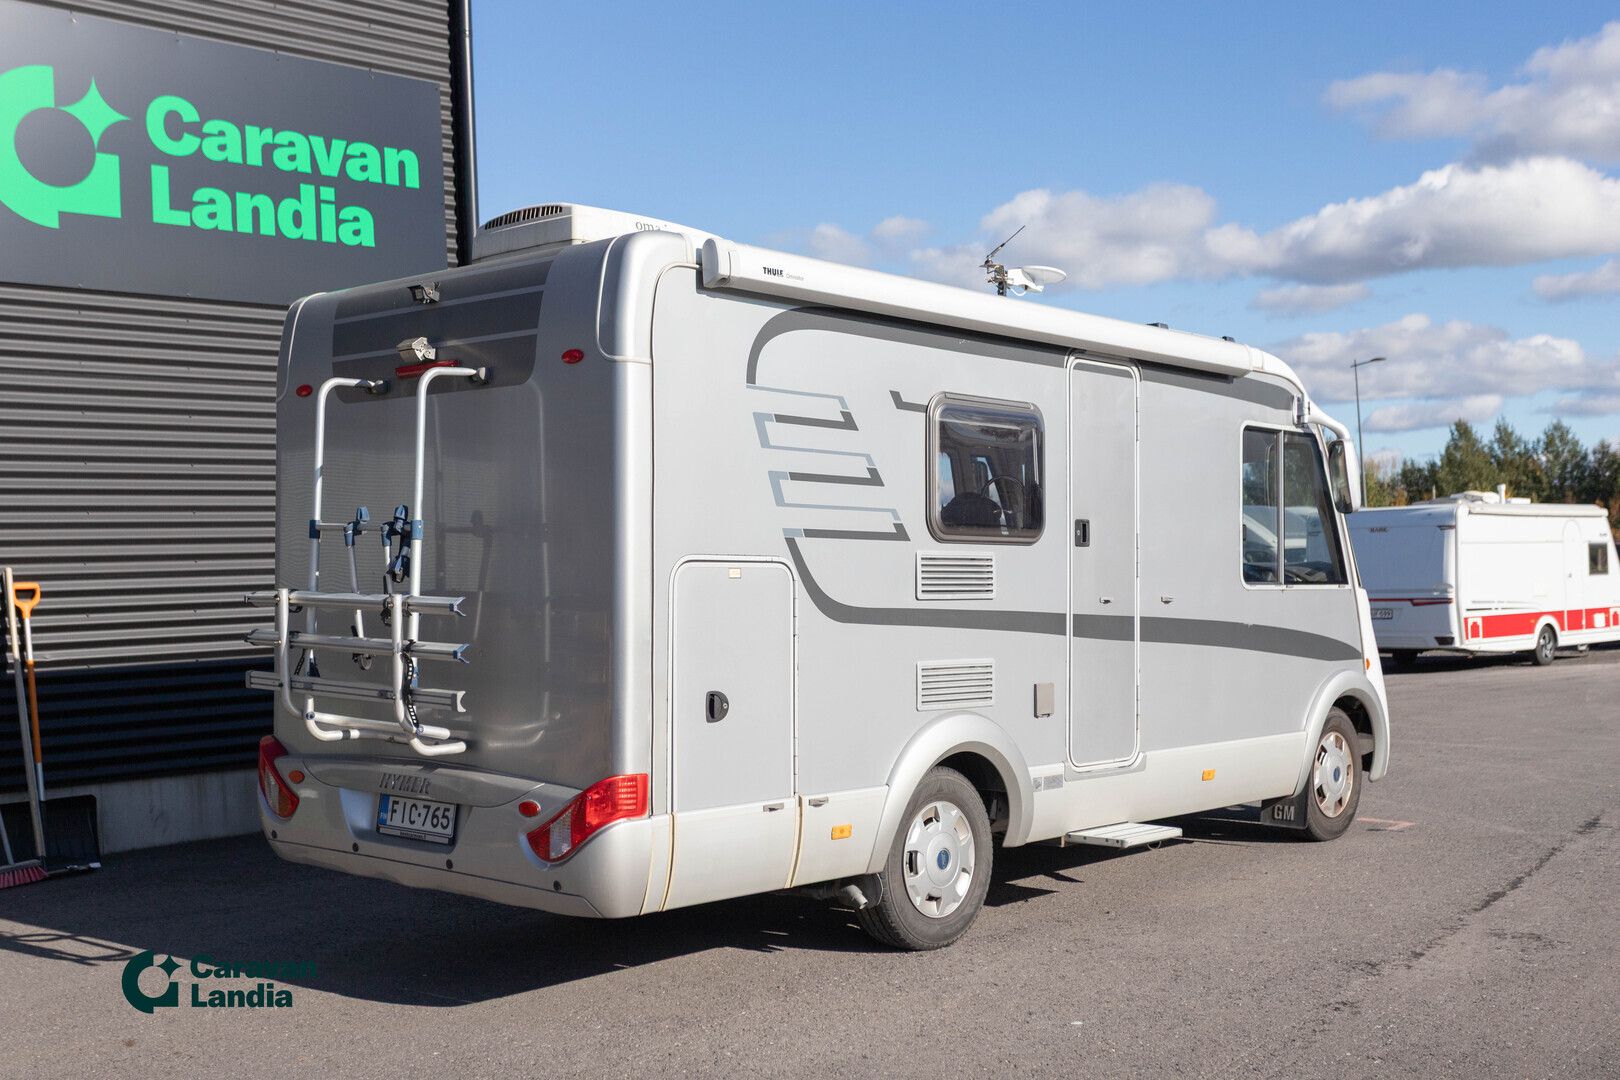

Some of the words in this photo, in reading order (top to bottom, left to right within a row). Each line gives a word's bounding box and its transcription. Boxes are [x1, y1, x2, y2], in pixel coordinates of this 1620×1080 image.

[146, 95, 420, 189] Caravan
[151, 164, 376, 248] Landia
[762, 266, 784, 276] THULE
[1272, 804, 1295, 821] GM
